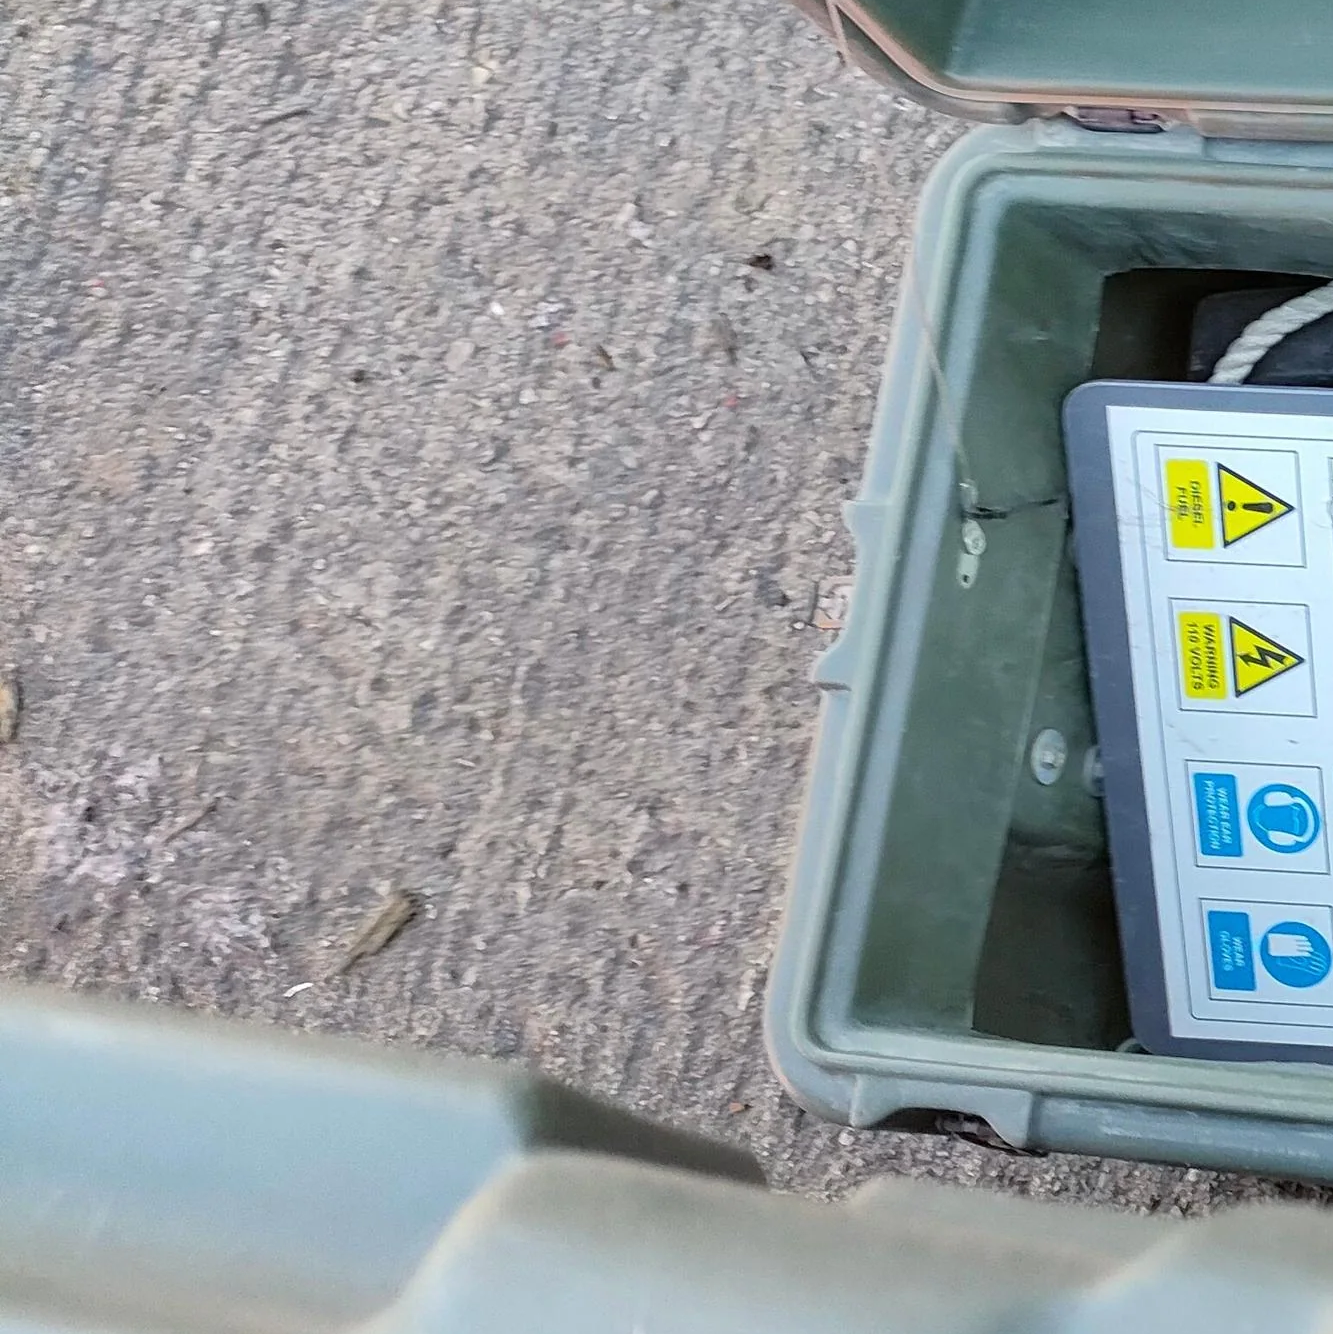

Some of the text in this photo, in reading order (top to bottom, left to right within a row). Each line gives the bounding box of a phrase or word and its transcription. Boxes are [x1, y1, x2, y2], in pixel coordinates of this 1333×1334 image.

[1174, 485, 1189, 521] FUEL
[1188, 479, 1204, 527] DIESEL
[1186, 622, 1204, 690] 110 VOLTS
[1202, 623, 1220, 690] WARNING
[1202, 779, 1220, 850] PROTECTION
[1215, 786, 1232, 843] WEAR EAR
[1218, 929, 1233, 971] GLOVES
[1230, 935, 1245, 967] WEAR
